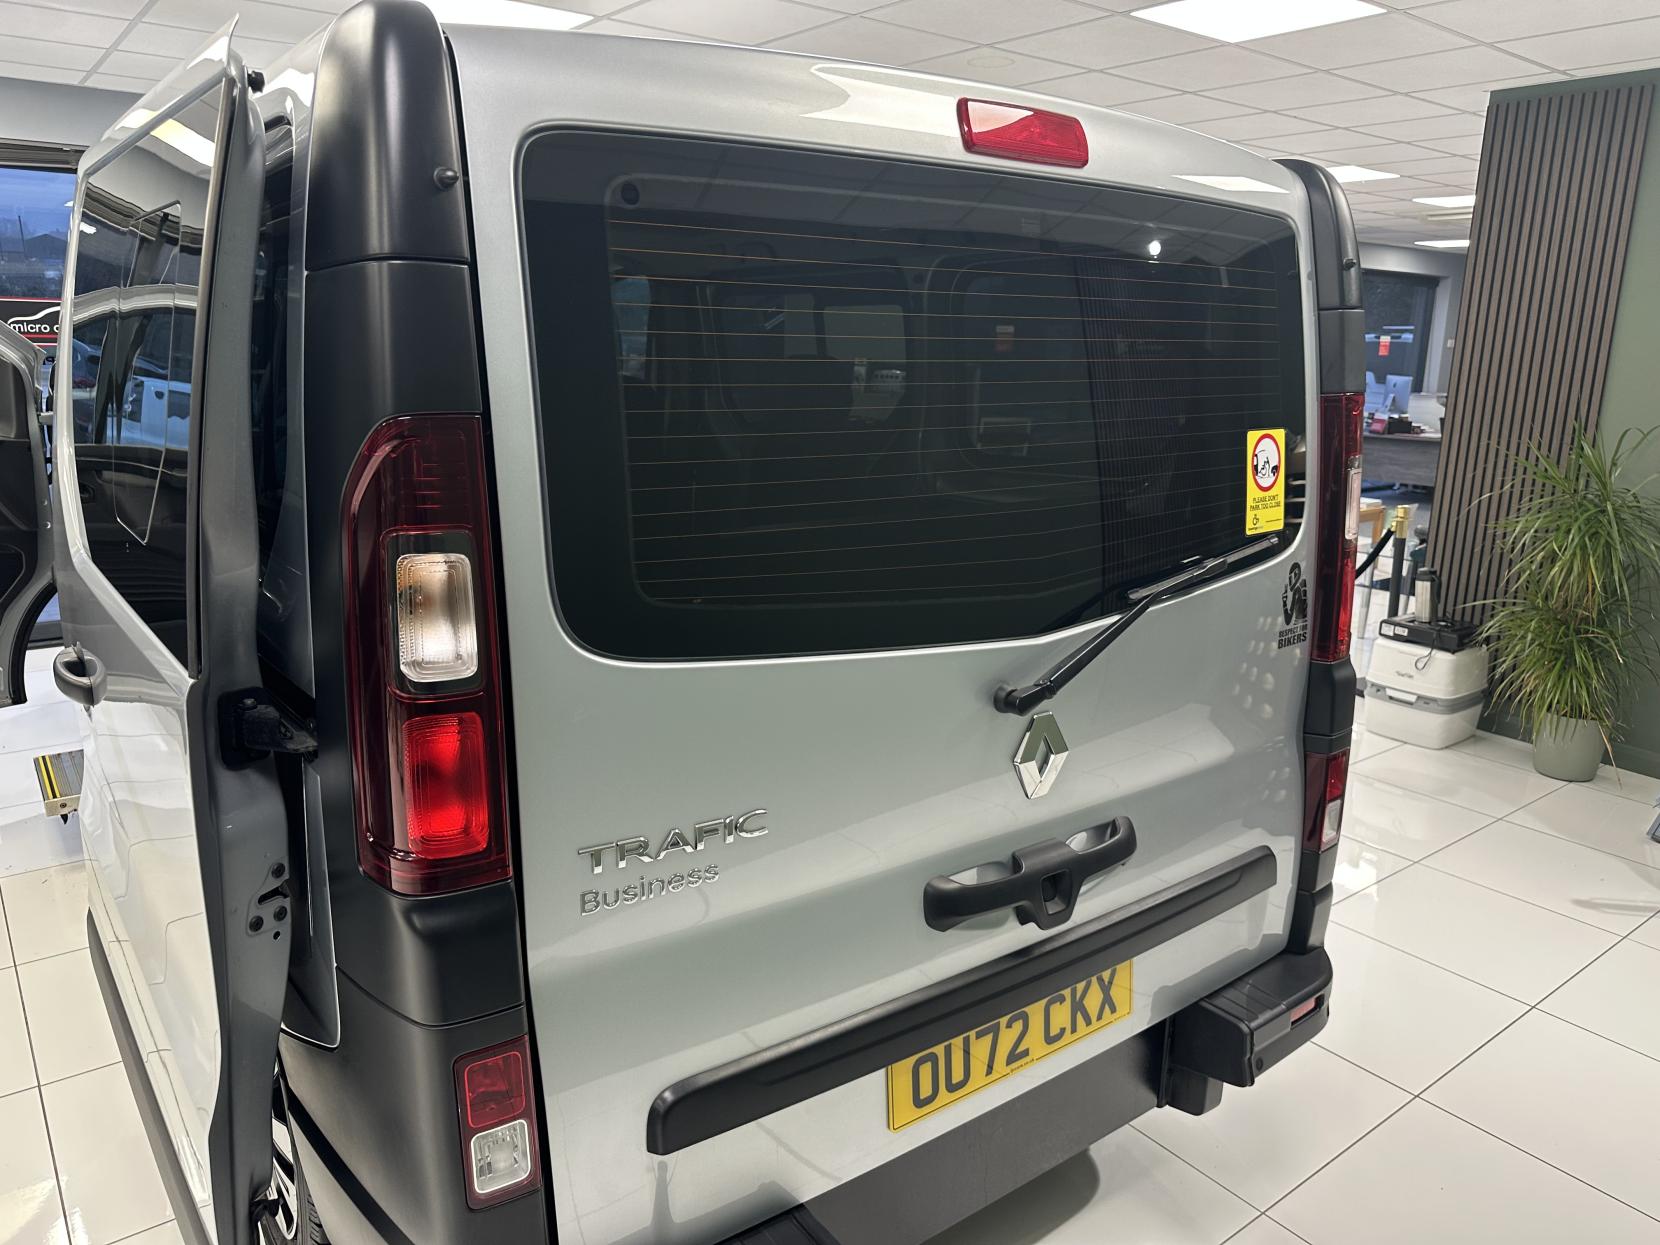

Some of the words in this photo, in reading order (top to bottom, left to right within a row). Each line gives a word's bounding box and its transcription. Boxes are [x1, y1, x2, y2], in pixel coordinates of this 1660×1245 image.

[1250, 503, 1260, 511] PARK
[1261, 502, 1269, 510] TOO
[1269, 501, 1281, 509] CLOSE
[1252, 495, 1268, 504] PLEASE
[1268, 494, 1279, 502] DON'T
[1279, 625, 1299, 638] RESPECT
[1299, 623, 1308, 632] FOR
[1277, 631, 1308, 650] BIKERS
[577, 808, 769, 875] TRAFIC
[579, 863, 720, 916] Business
[911, 1010, 1030, 1110] OU72
[1043, 967, 1118, 1046] CKX
